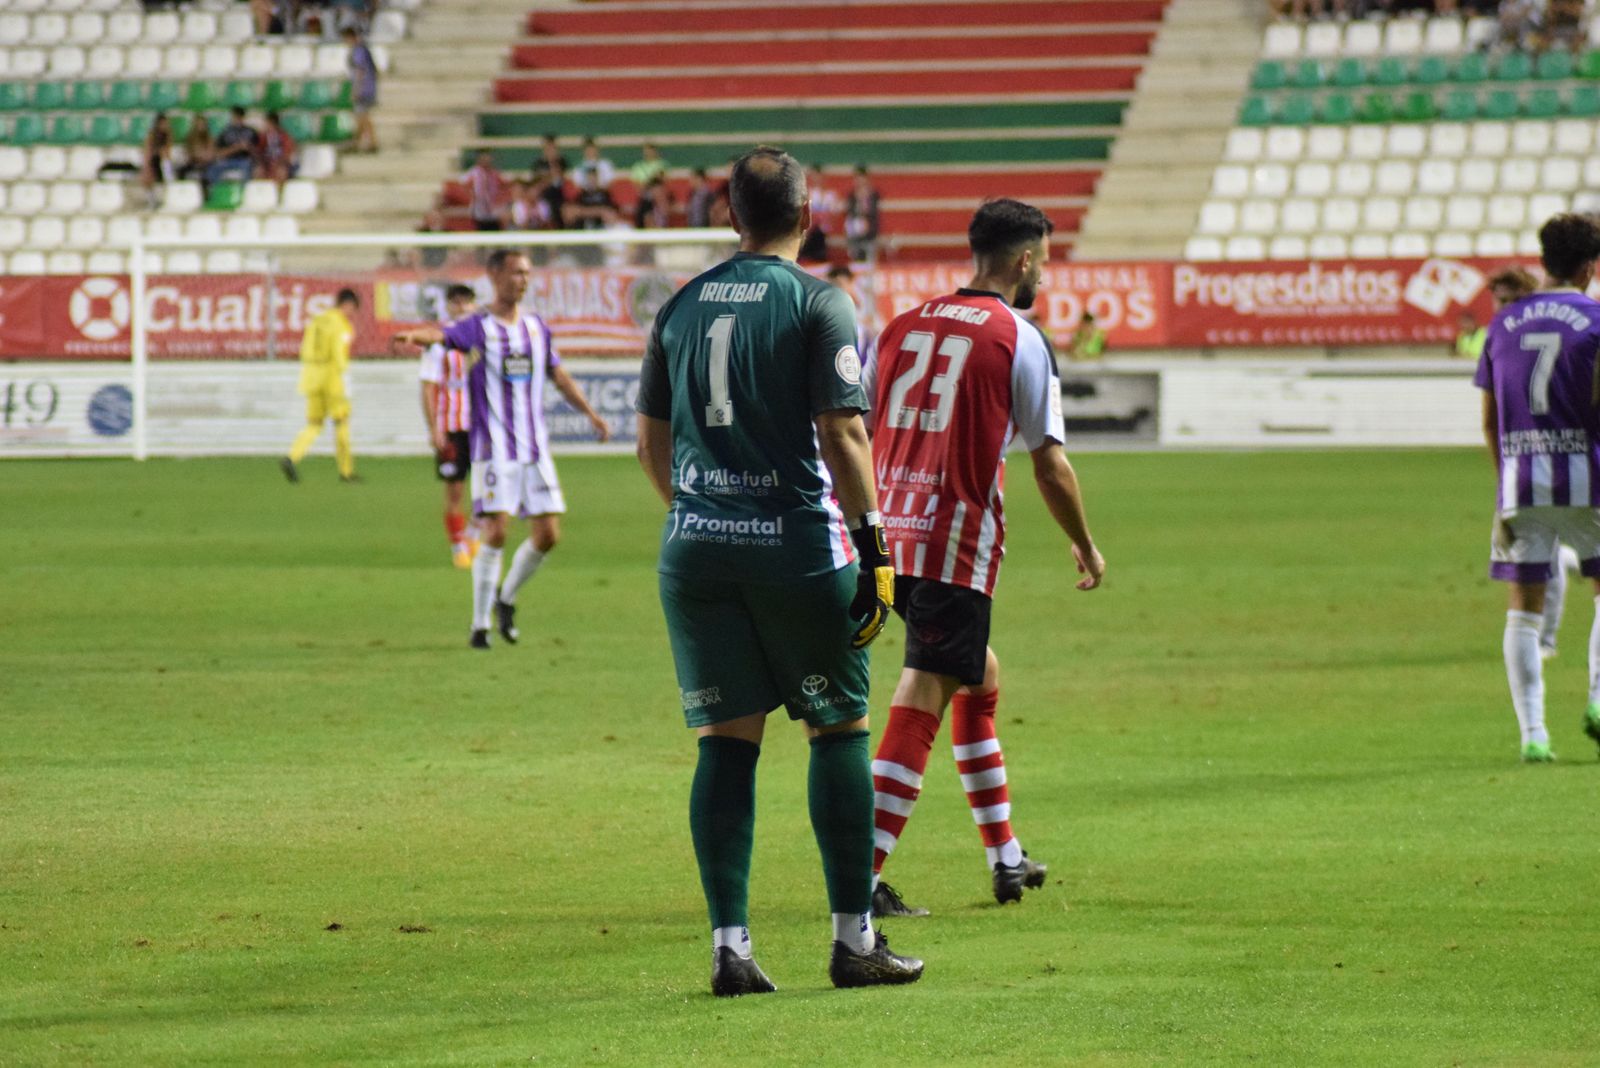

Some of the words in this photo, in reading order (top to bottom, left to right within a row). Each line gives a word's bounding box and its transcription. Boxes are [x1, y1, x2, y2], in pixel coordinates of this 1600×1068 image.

[698, 282, 769, 302] IRICIBAR
[1174, 264, 1398, 313] Progesdatos
[145, 285, 337, 333] Cualtis
[1503, 301, 1591, 332] R.ARROYO
[705, 314, 736, 427] 1
[887, 331, 973, 432] 23
[1520, 332, 1561, 416] 7
[704, 468, 779, 487] Villafuel
[682, 513, 783, 534] Pronatal
[880, 513, 936, 531] ronatal
[680, 531, 727, 544] Medical
[731, 535, 783, 546] Services
